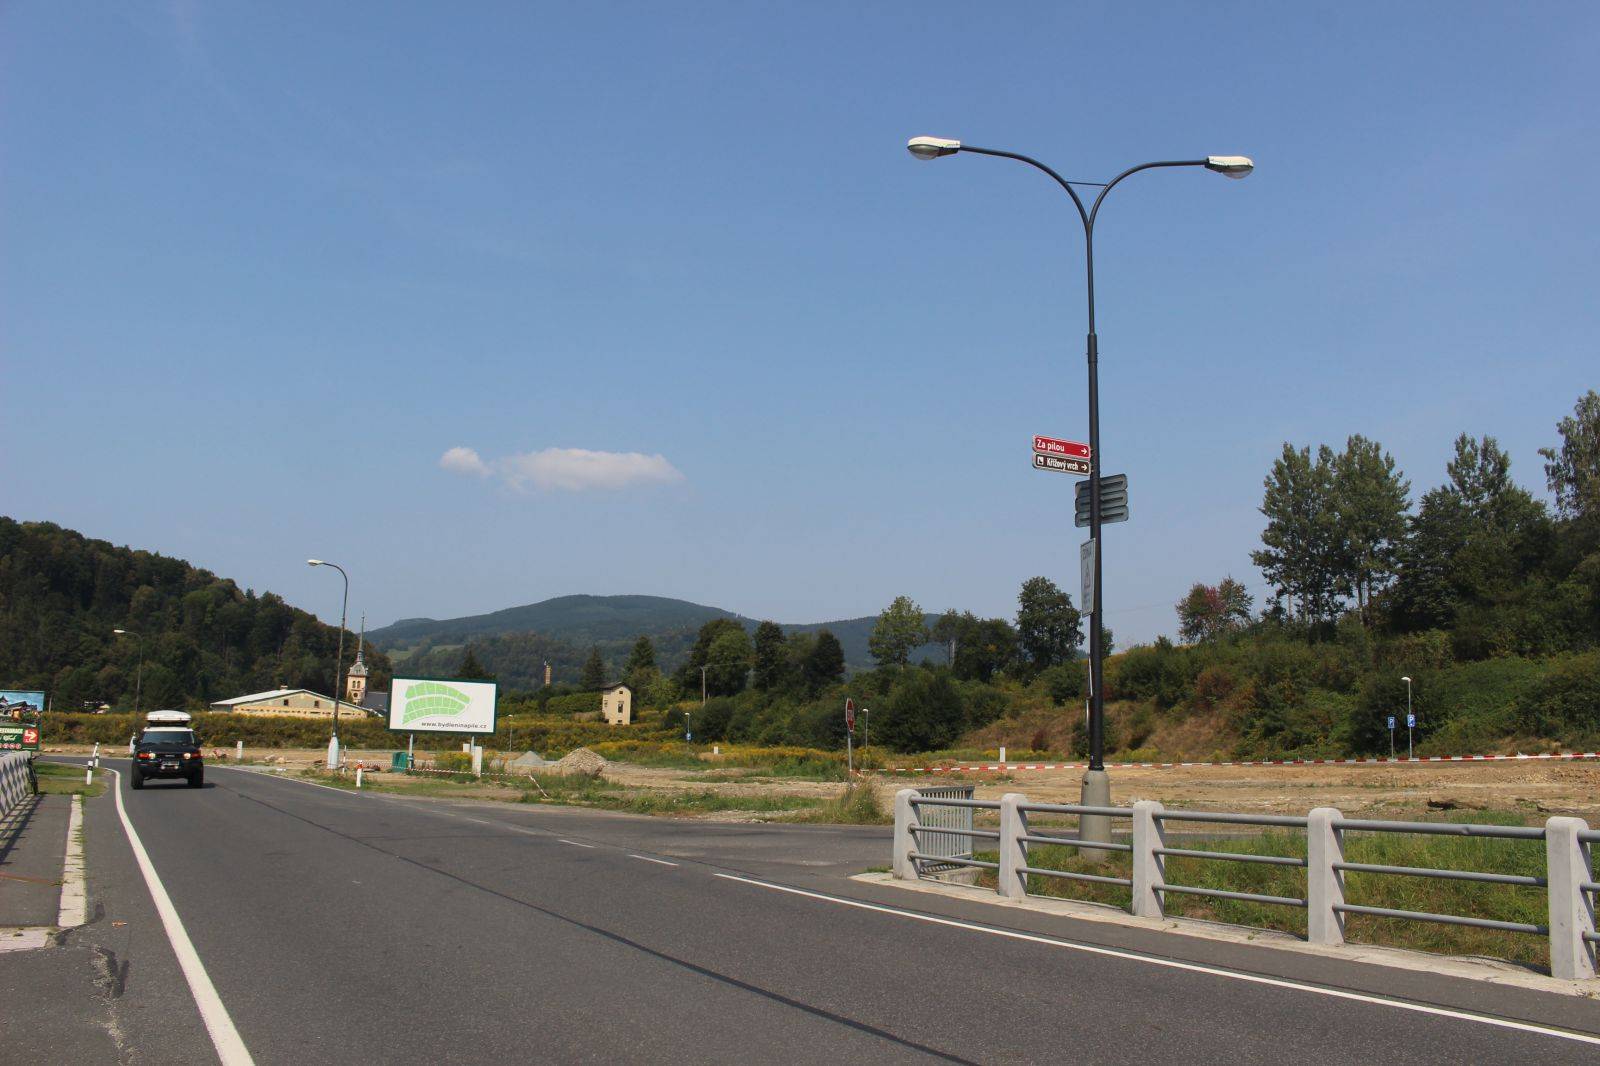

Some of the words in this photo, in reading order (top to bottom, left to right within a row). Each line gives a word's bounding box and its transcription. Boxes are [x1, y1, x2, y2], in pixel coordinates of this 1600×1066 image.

[1036, 439, 1046, 449] Za
[1047, 441, 1065, 452] pilou
[1067, 462, 1079, 471] vrch
